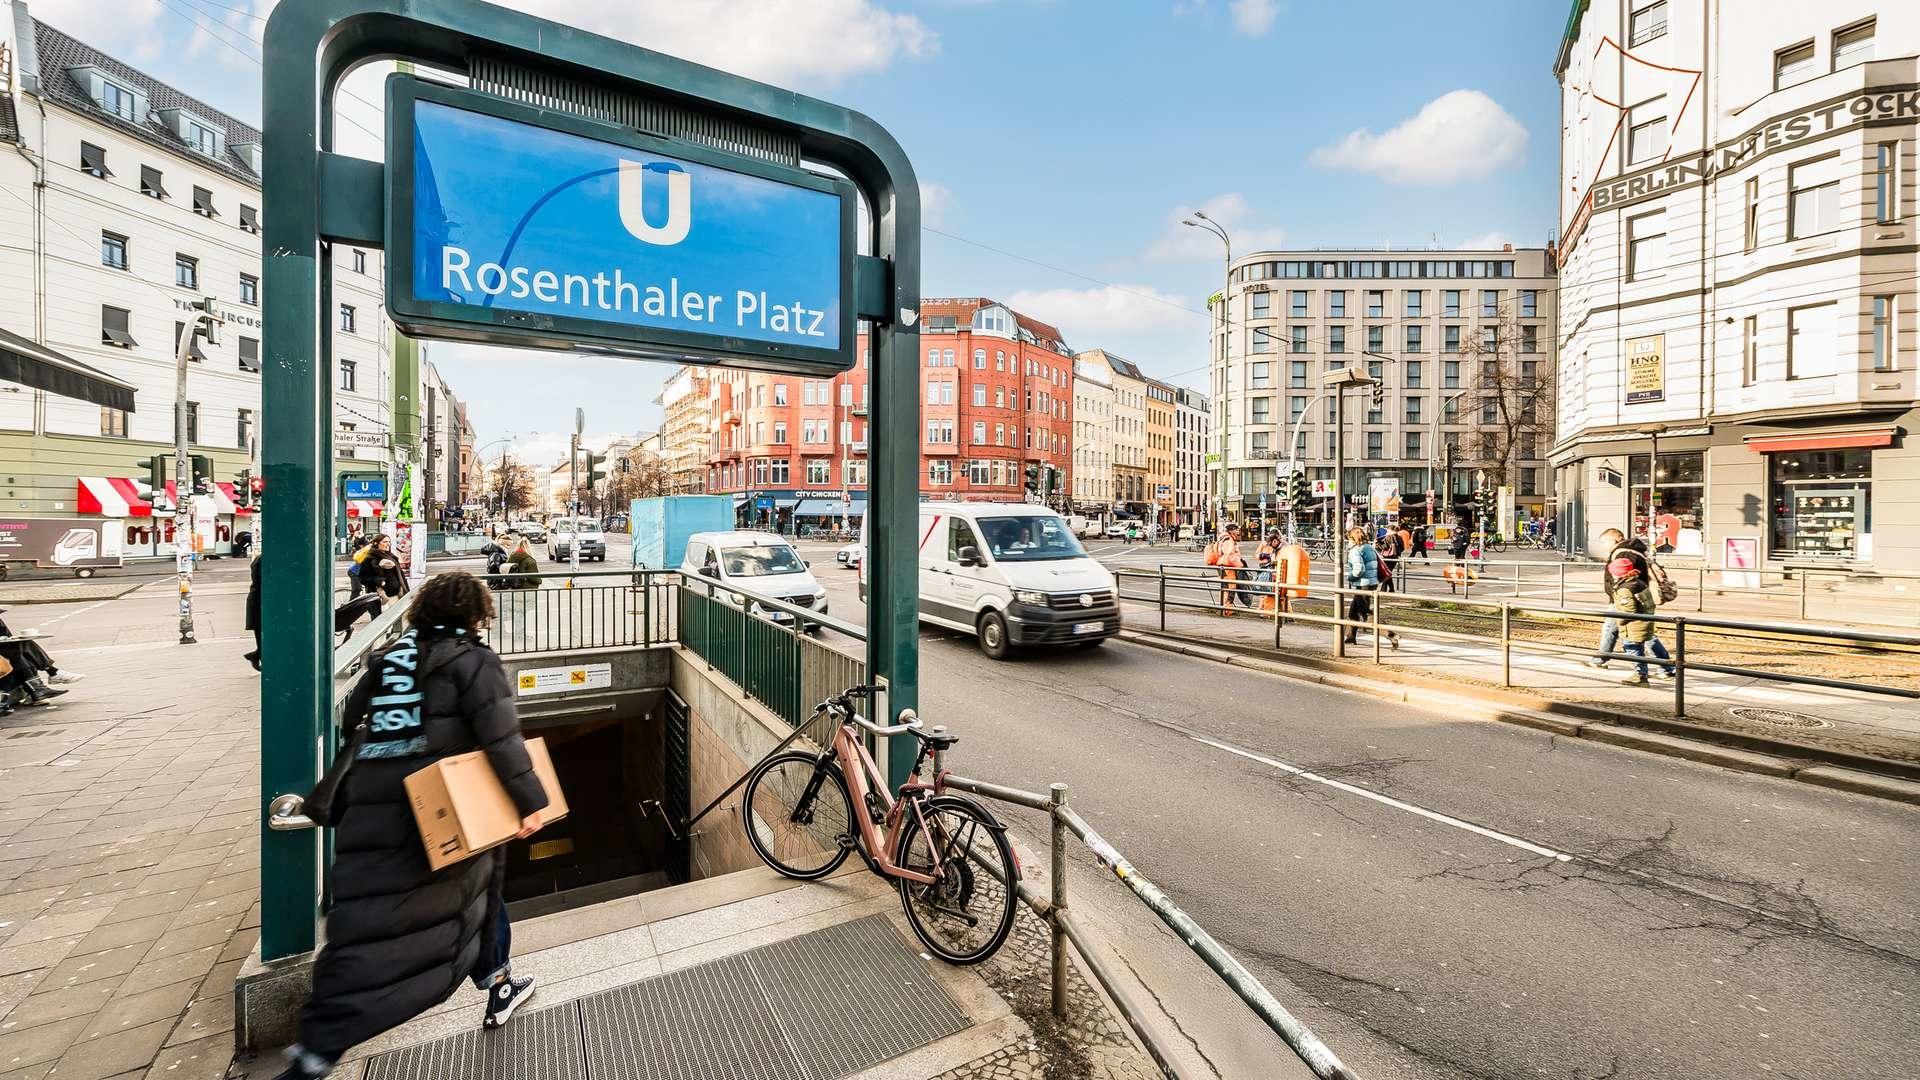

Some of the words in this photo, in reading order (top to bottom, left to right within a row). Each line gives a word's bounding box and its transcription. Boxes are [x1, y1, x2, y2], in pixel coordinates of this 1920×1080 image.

[1593, 157, 1706, 209] BERLIN
[619, 158, 691, 246] U
[442, 245, 722, 323] Rosenthaler
[736, 290, 825, 337] Platz
[1631, 355, 1660, 366] HNO
[356, 434, 381, 444] Straße
[361, 481, 369, 491] U
